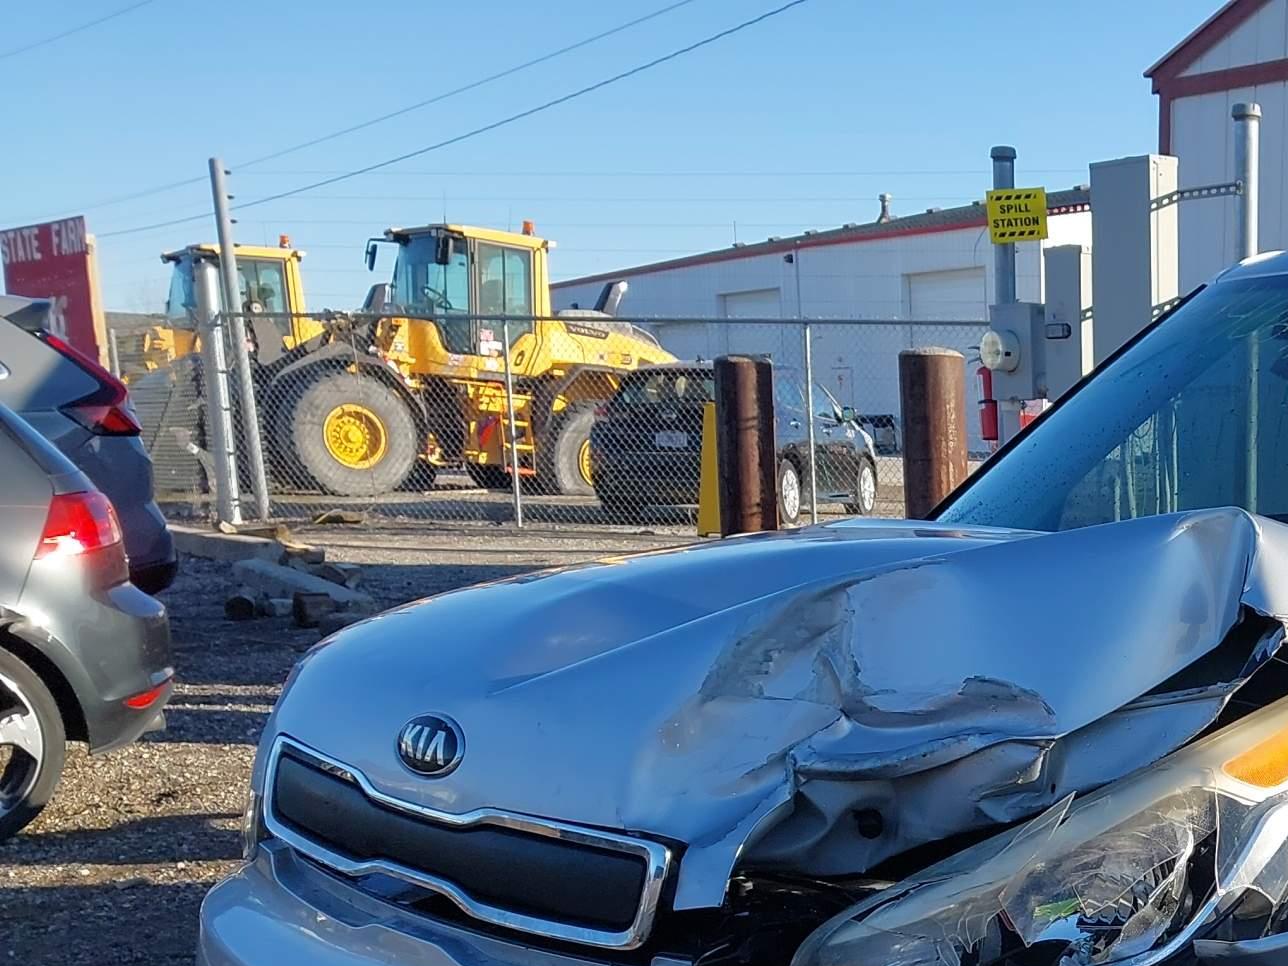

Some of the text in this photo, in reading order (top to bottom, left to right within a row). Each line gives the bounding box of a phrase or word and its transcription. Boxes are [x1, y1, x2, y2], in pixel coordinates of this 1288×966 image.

[993, 216, 1040, 228] STATION
[999, 203, 1031, 214] SPILL
[1, 218, 86, 264] STATE FARM
[401, 722, 446, 767] KIA
